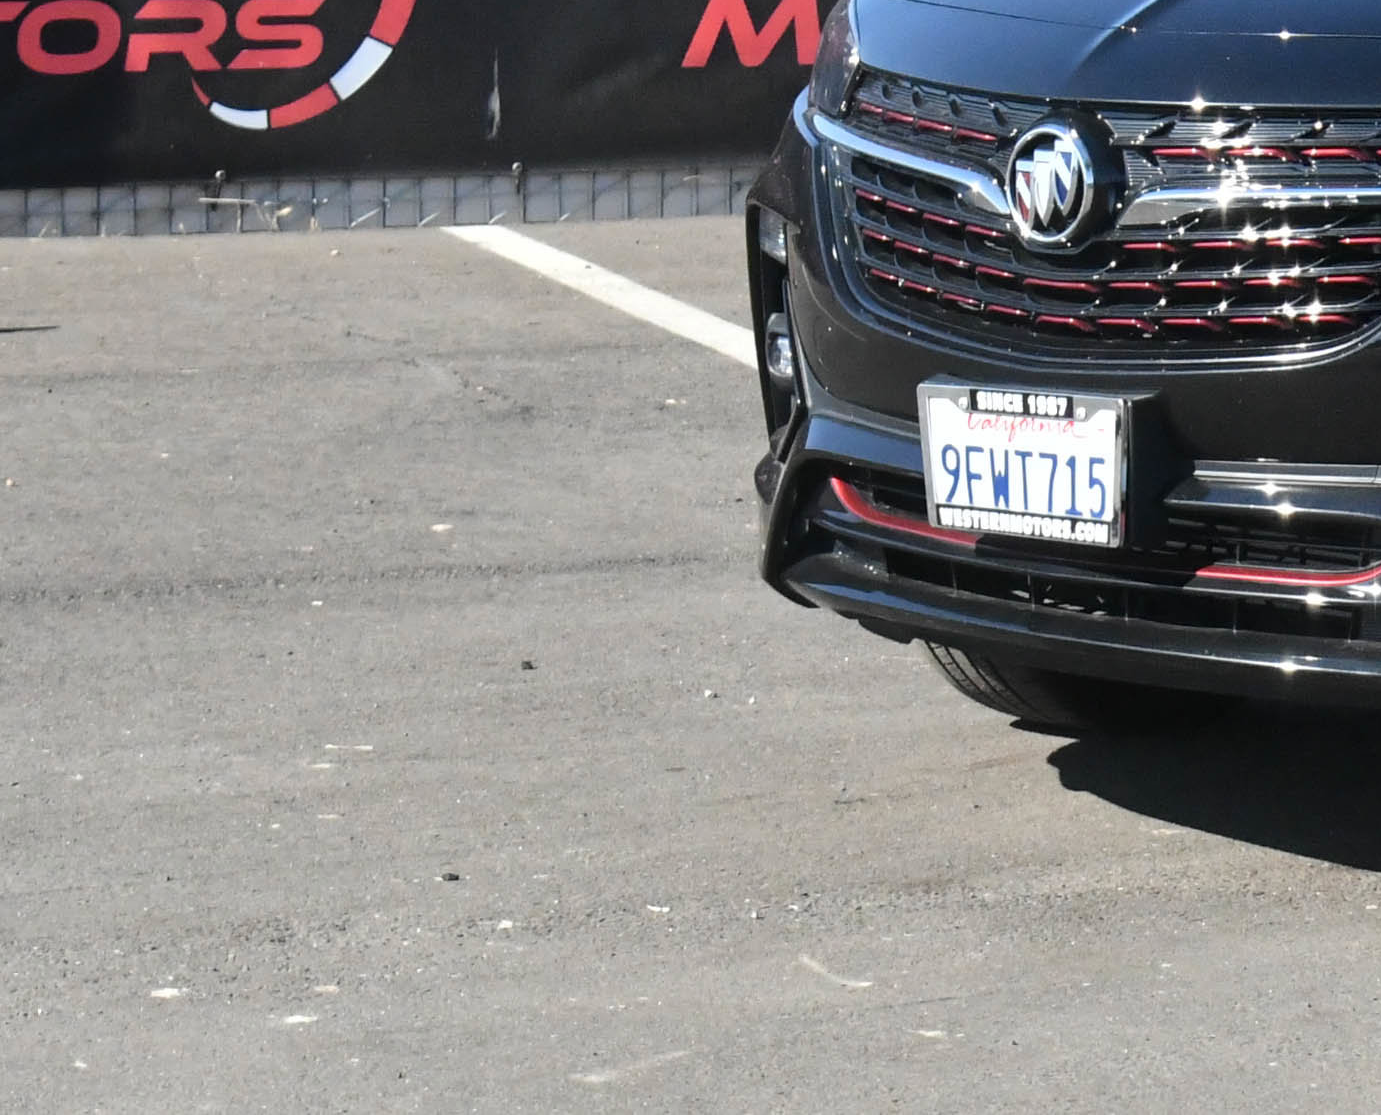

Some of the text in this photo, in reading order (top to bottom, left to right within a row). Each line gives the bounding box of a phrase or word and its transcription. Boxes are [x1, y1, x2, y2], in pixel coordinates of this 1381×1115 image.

[976, 391, 1023, 413] SINCE
[967, 411, 1084, 442] California
[940, 443, 1107, 519] 9FWT715
[939, 507, 1109, 544] WESTERNMOTORS.COM
